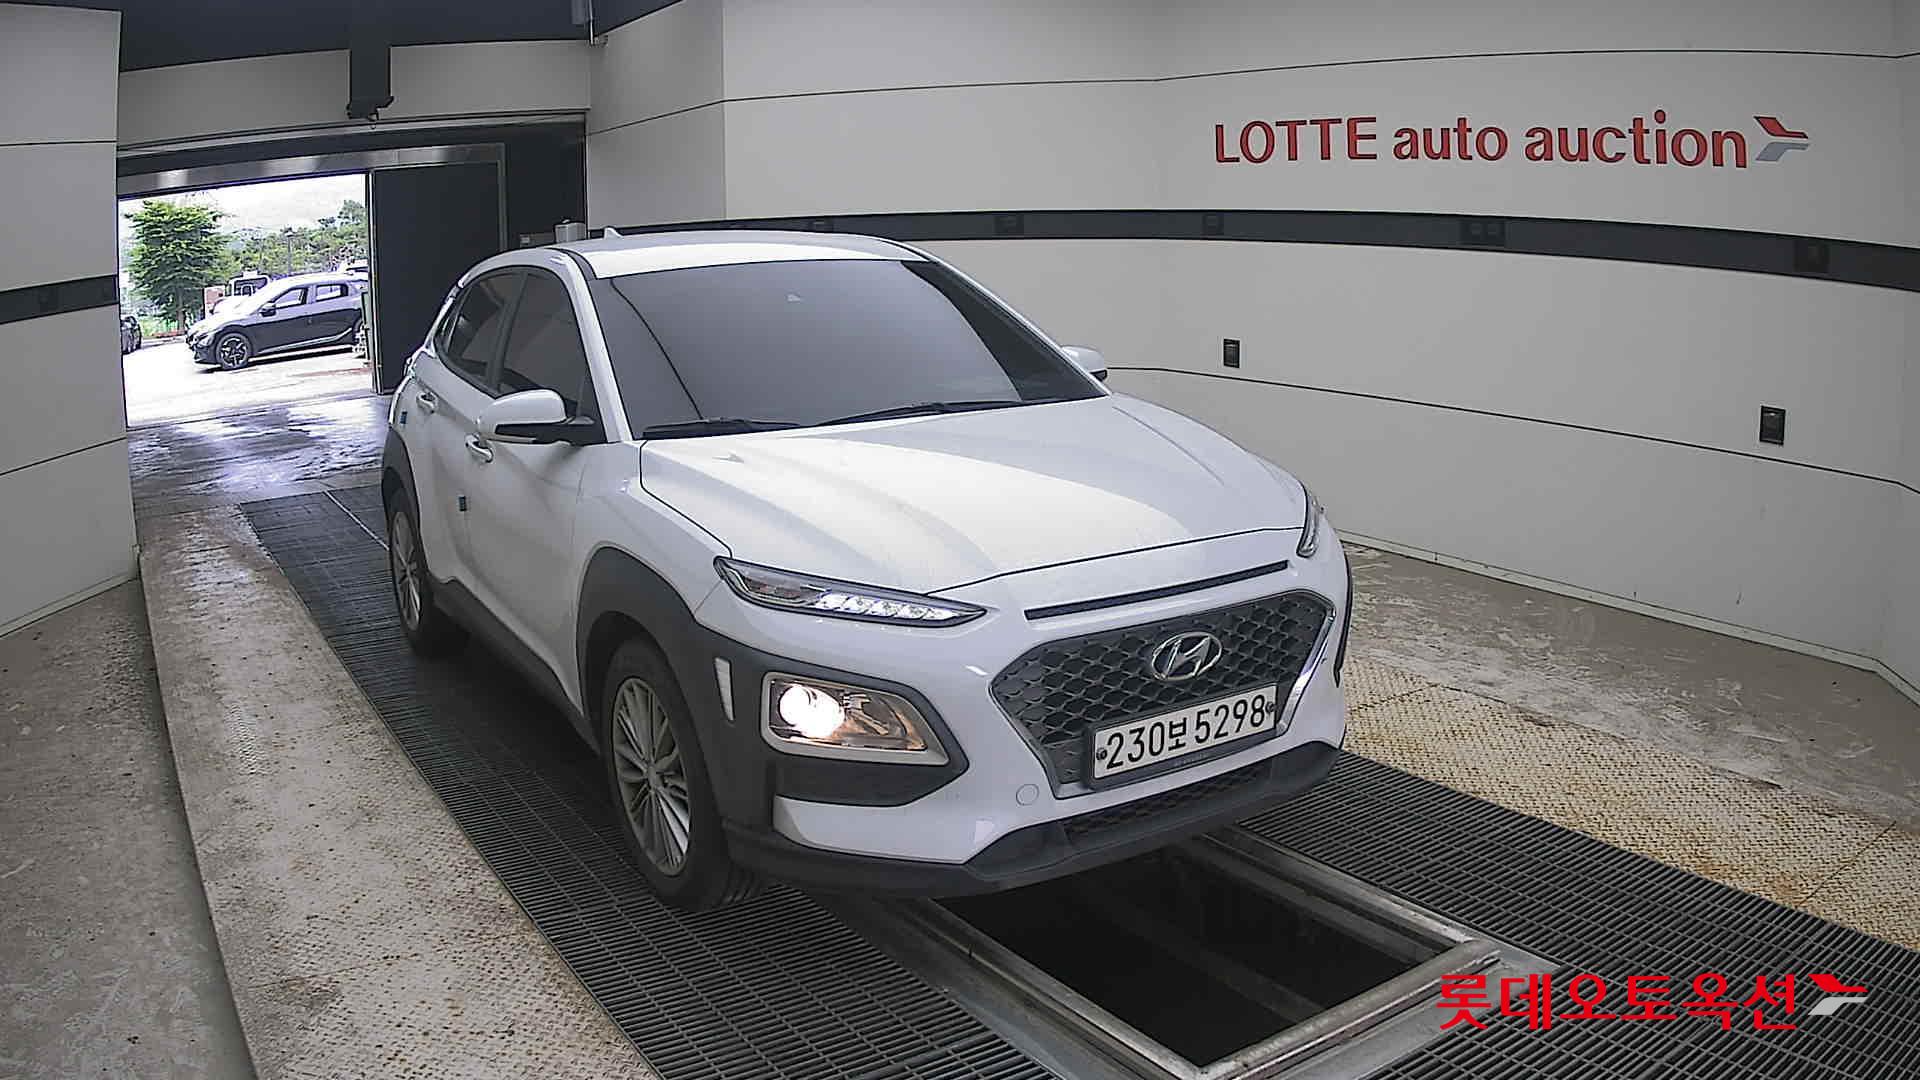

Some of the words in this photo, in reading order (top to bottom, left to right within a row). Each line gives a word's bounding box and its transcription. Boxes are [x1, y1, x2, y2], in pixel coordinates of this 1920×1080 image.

[1215, 116, 1377, 164] LOTTE
[1393, 117, 1508, 162] auto
[1523, 109, 1748, 169] auction
[1106, 716, 1187, 769] 230보
[1194, 694, 1266, 744] 5298
